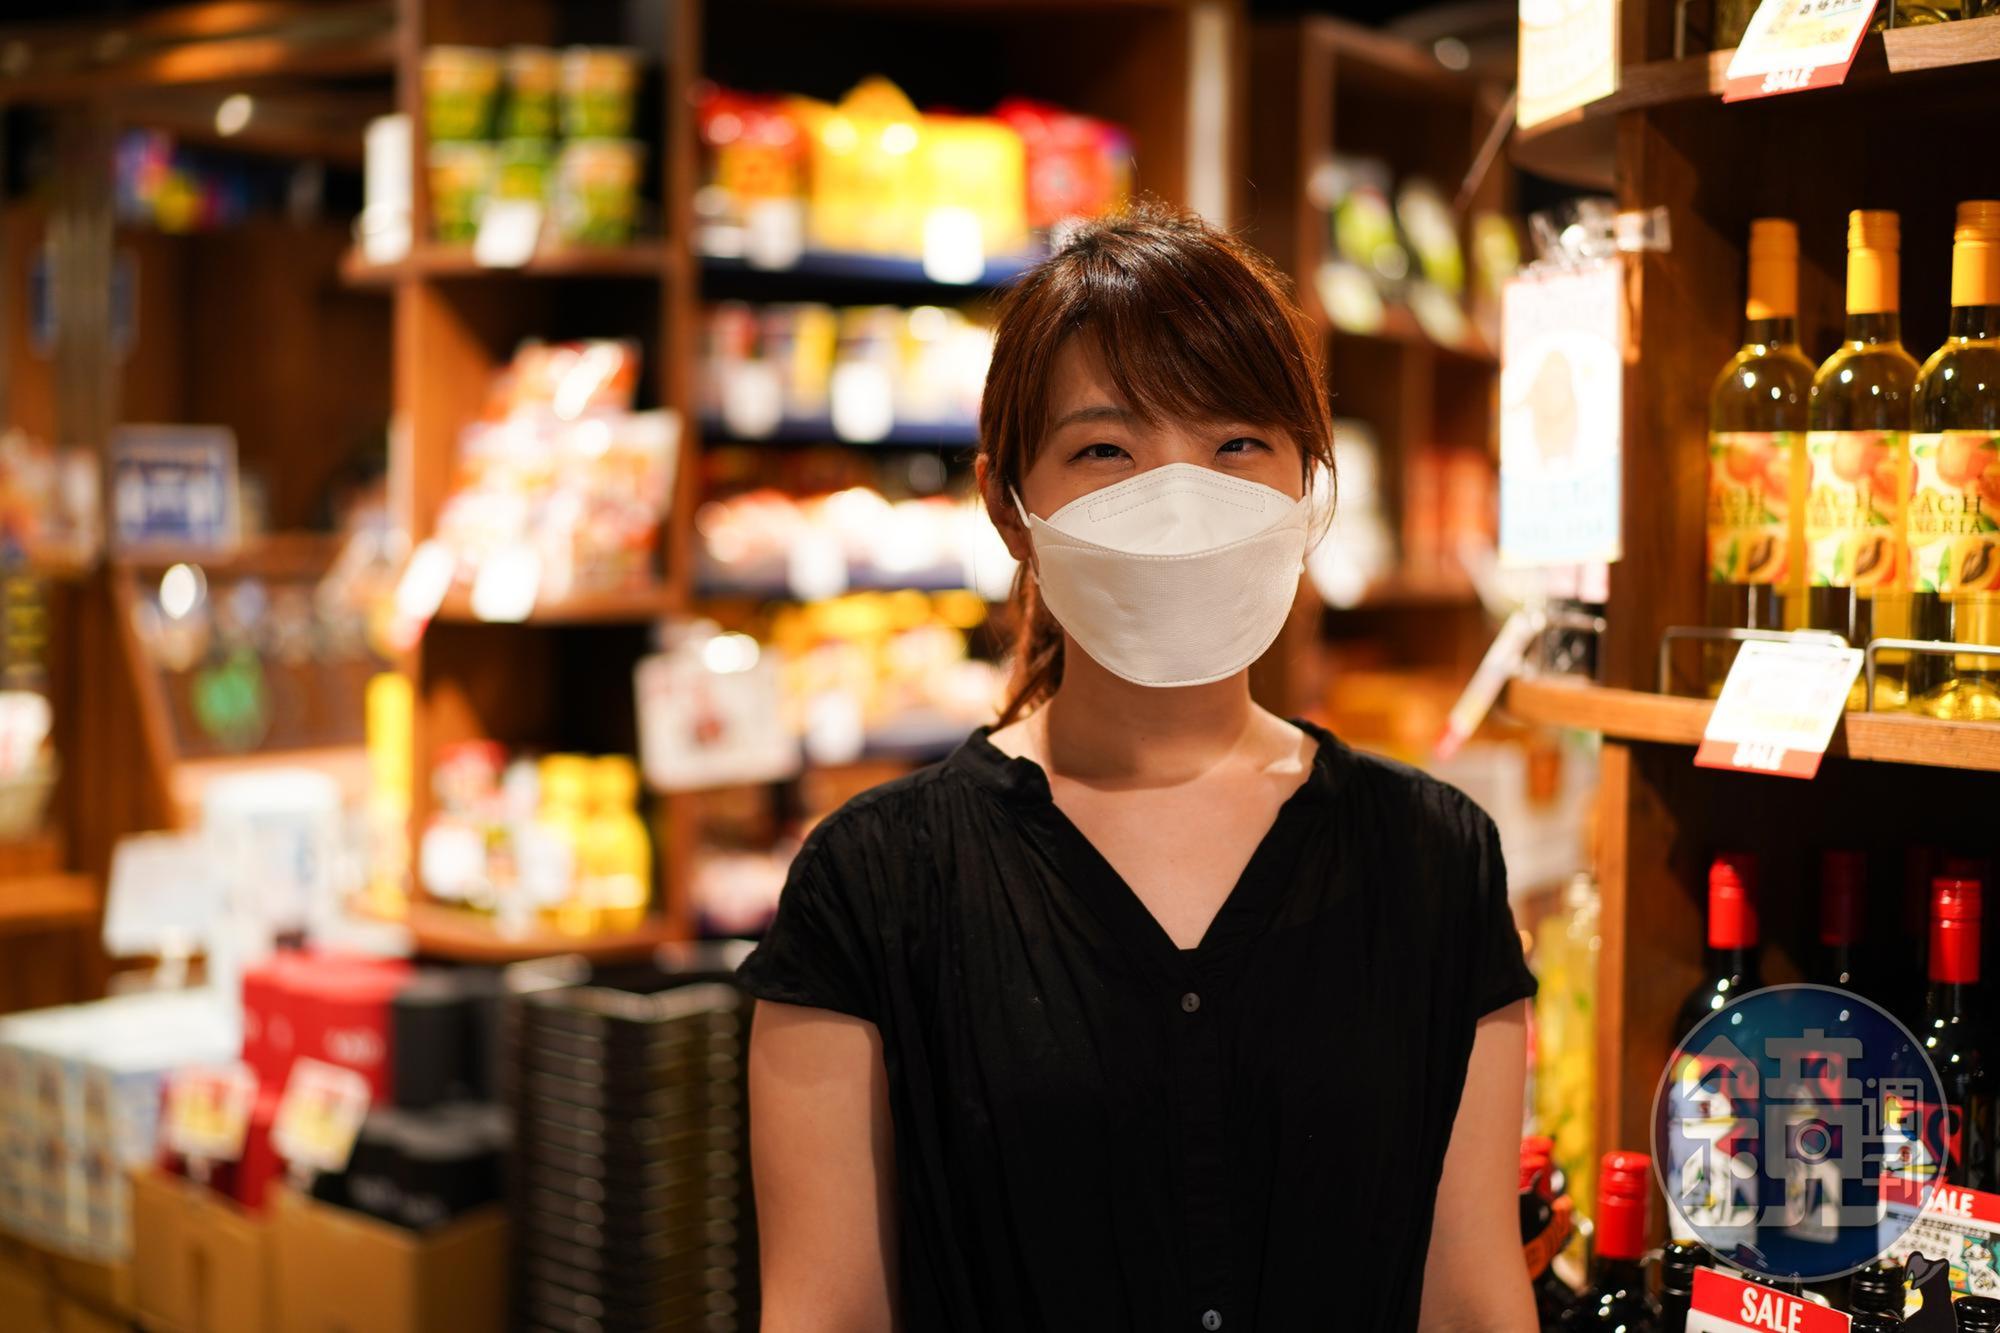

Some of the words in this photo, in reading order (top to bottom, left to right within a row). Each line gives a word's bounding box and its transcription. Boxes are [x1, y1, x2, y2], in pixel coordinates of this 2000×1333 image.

[1761, 65, 1816, 93] SALE
[1920, 1185, 1974, 1218] SALE
[1740, 1287, 1804, 1333] SALE
